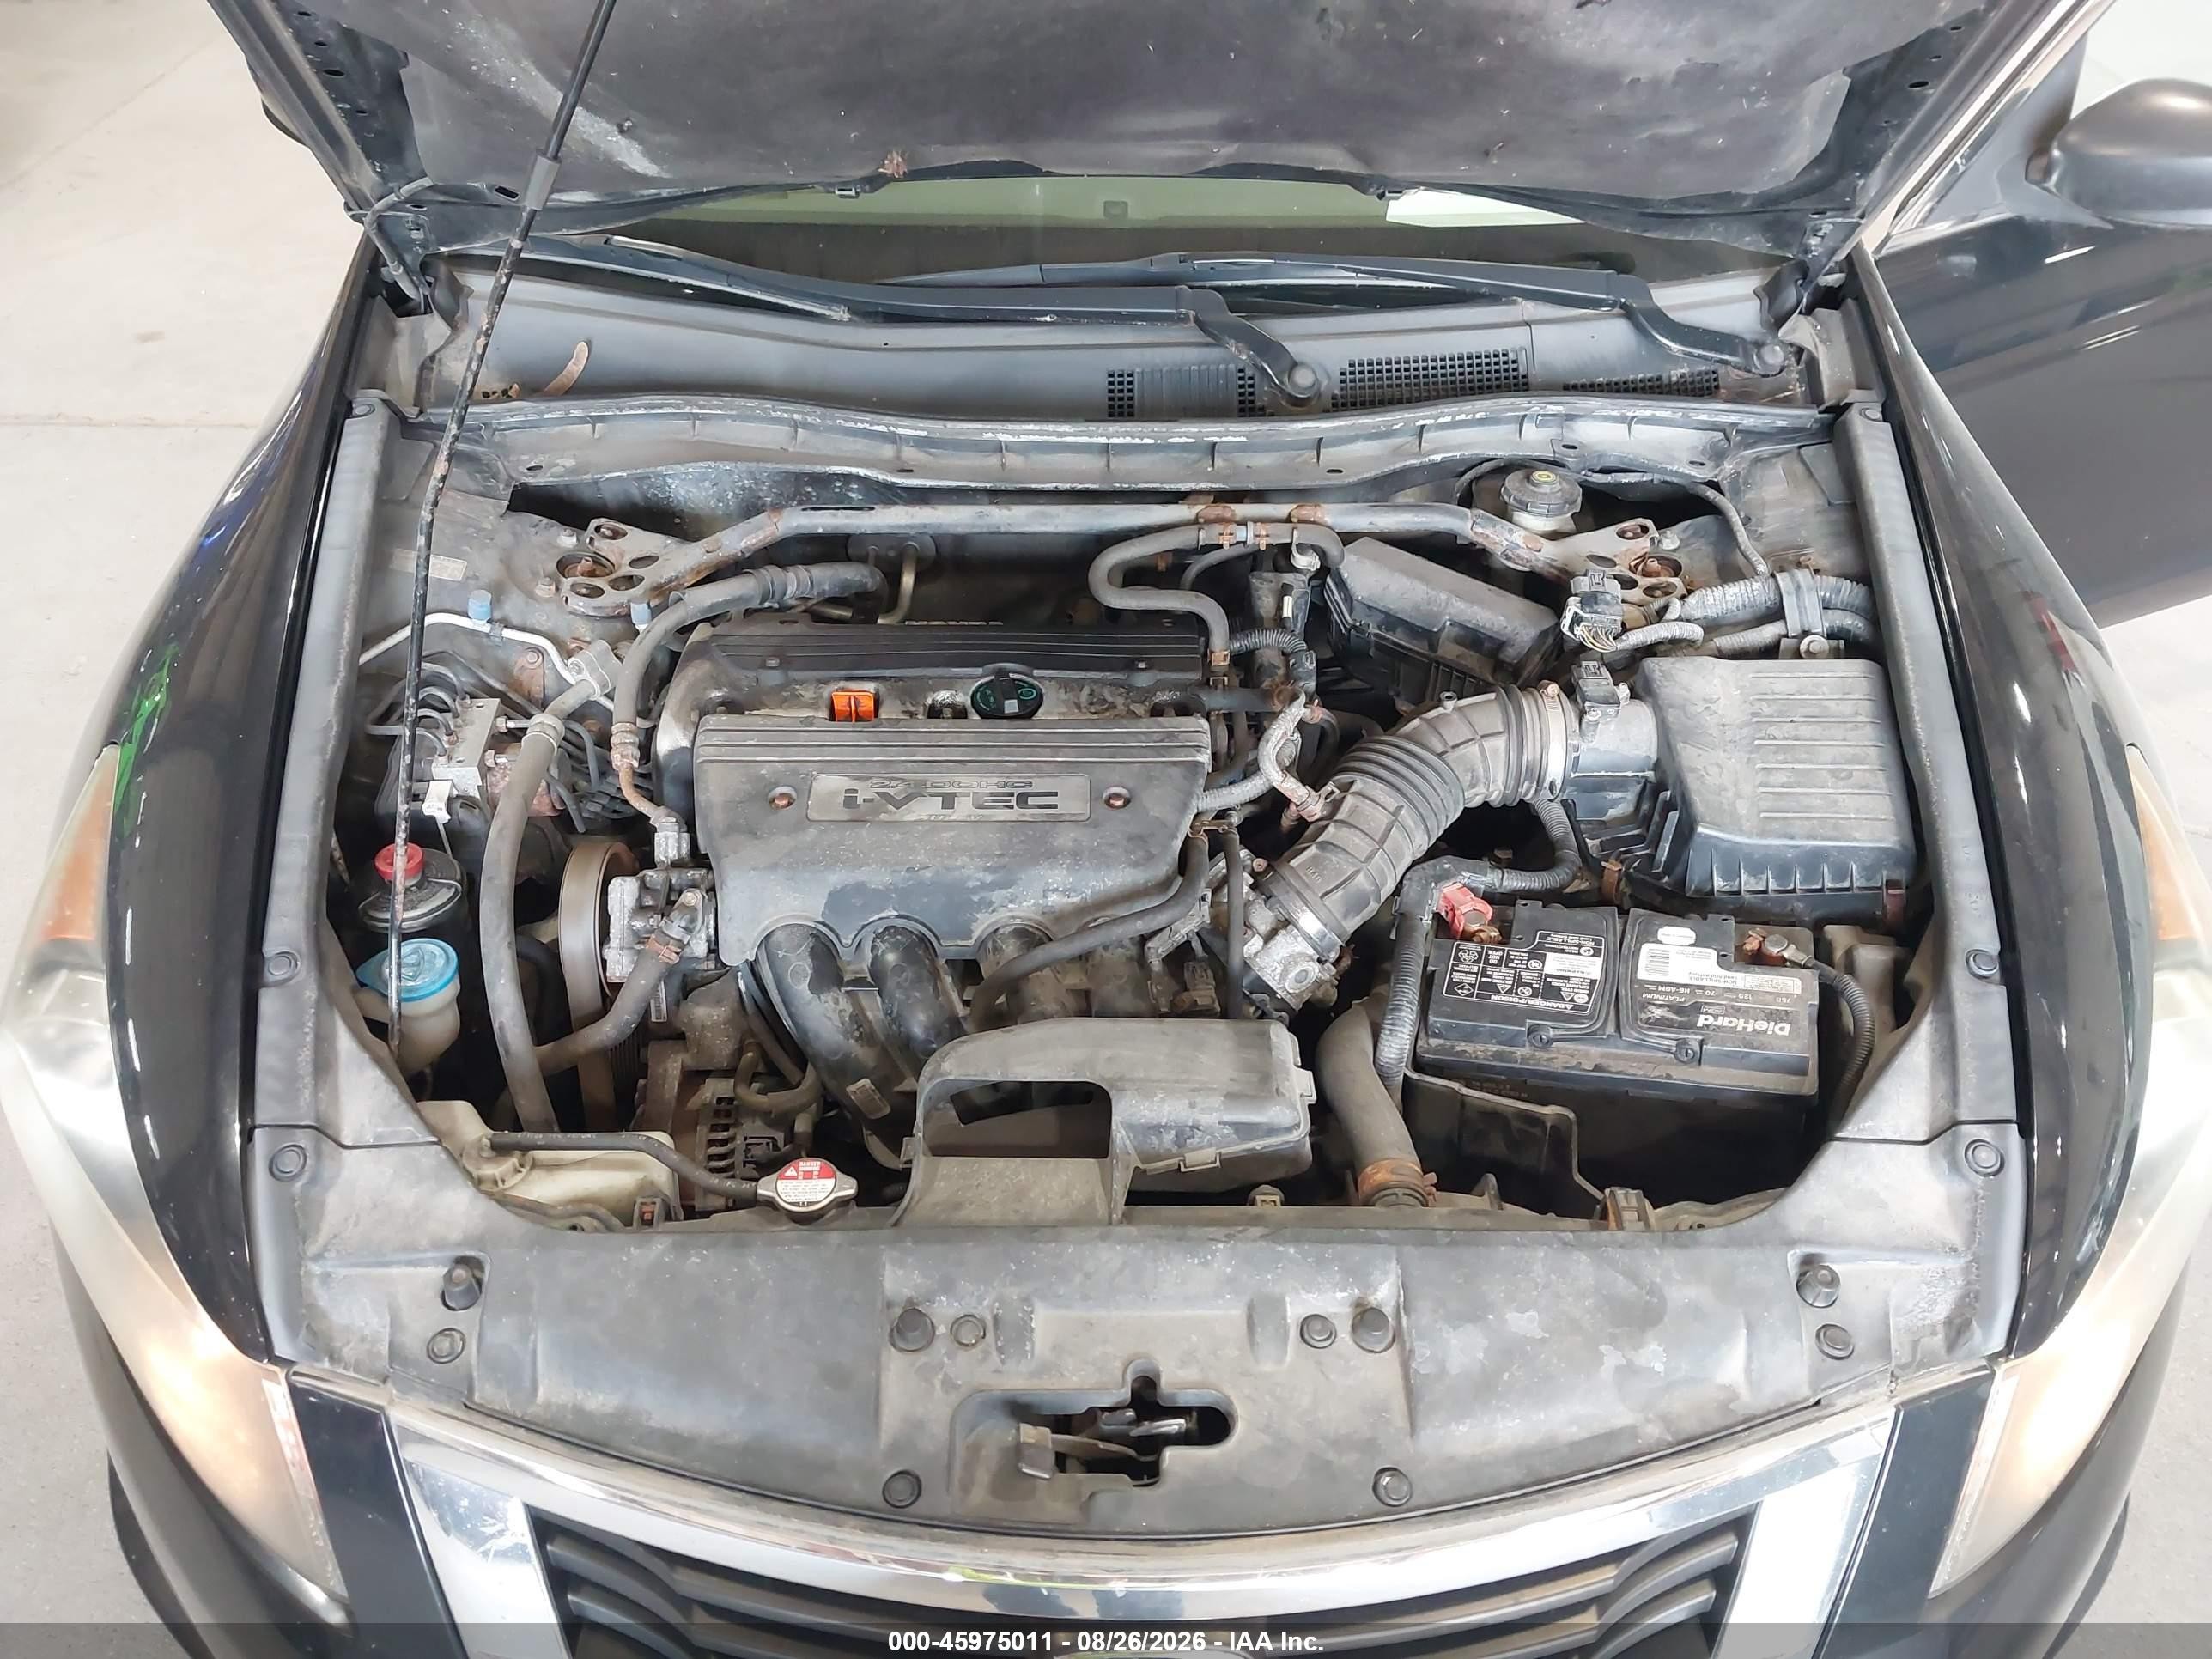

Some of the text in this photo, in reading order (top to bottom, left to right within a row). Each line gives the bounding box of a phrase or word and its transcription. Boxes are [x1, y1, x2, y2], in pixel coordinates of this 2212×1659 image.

[922, 780, 1034, 789] DOHC
[842, 787, 1059, 811] i-VTEC
[1642, 992, 1686, 1002] PLATINUM
[1696, 1014, 1791, 1036] DieHard
